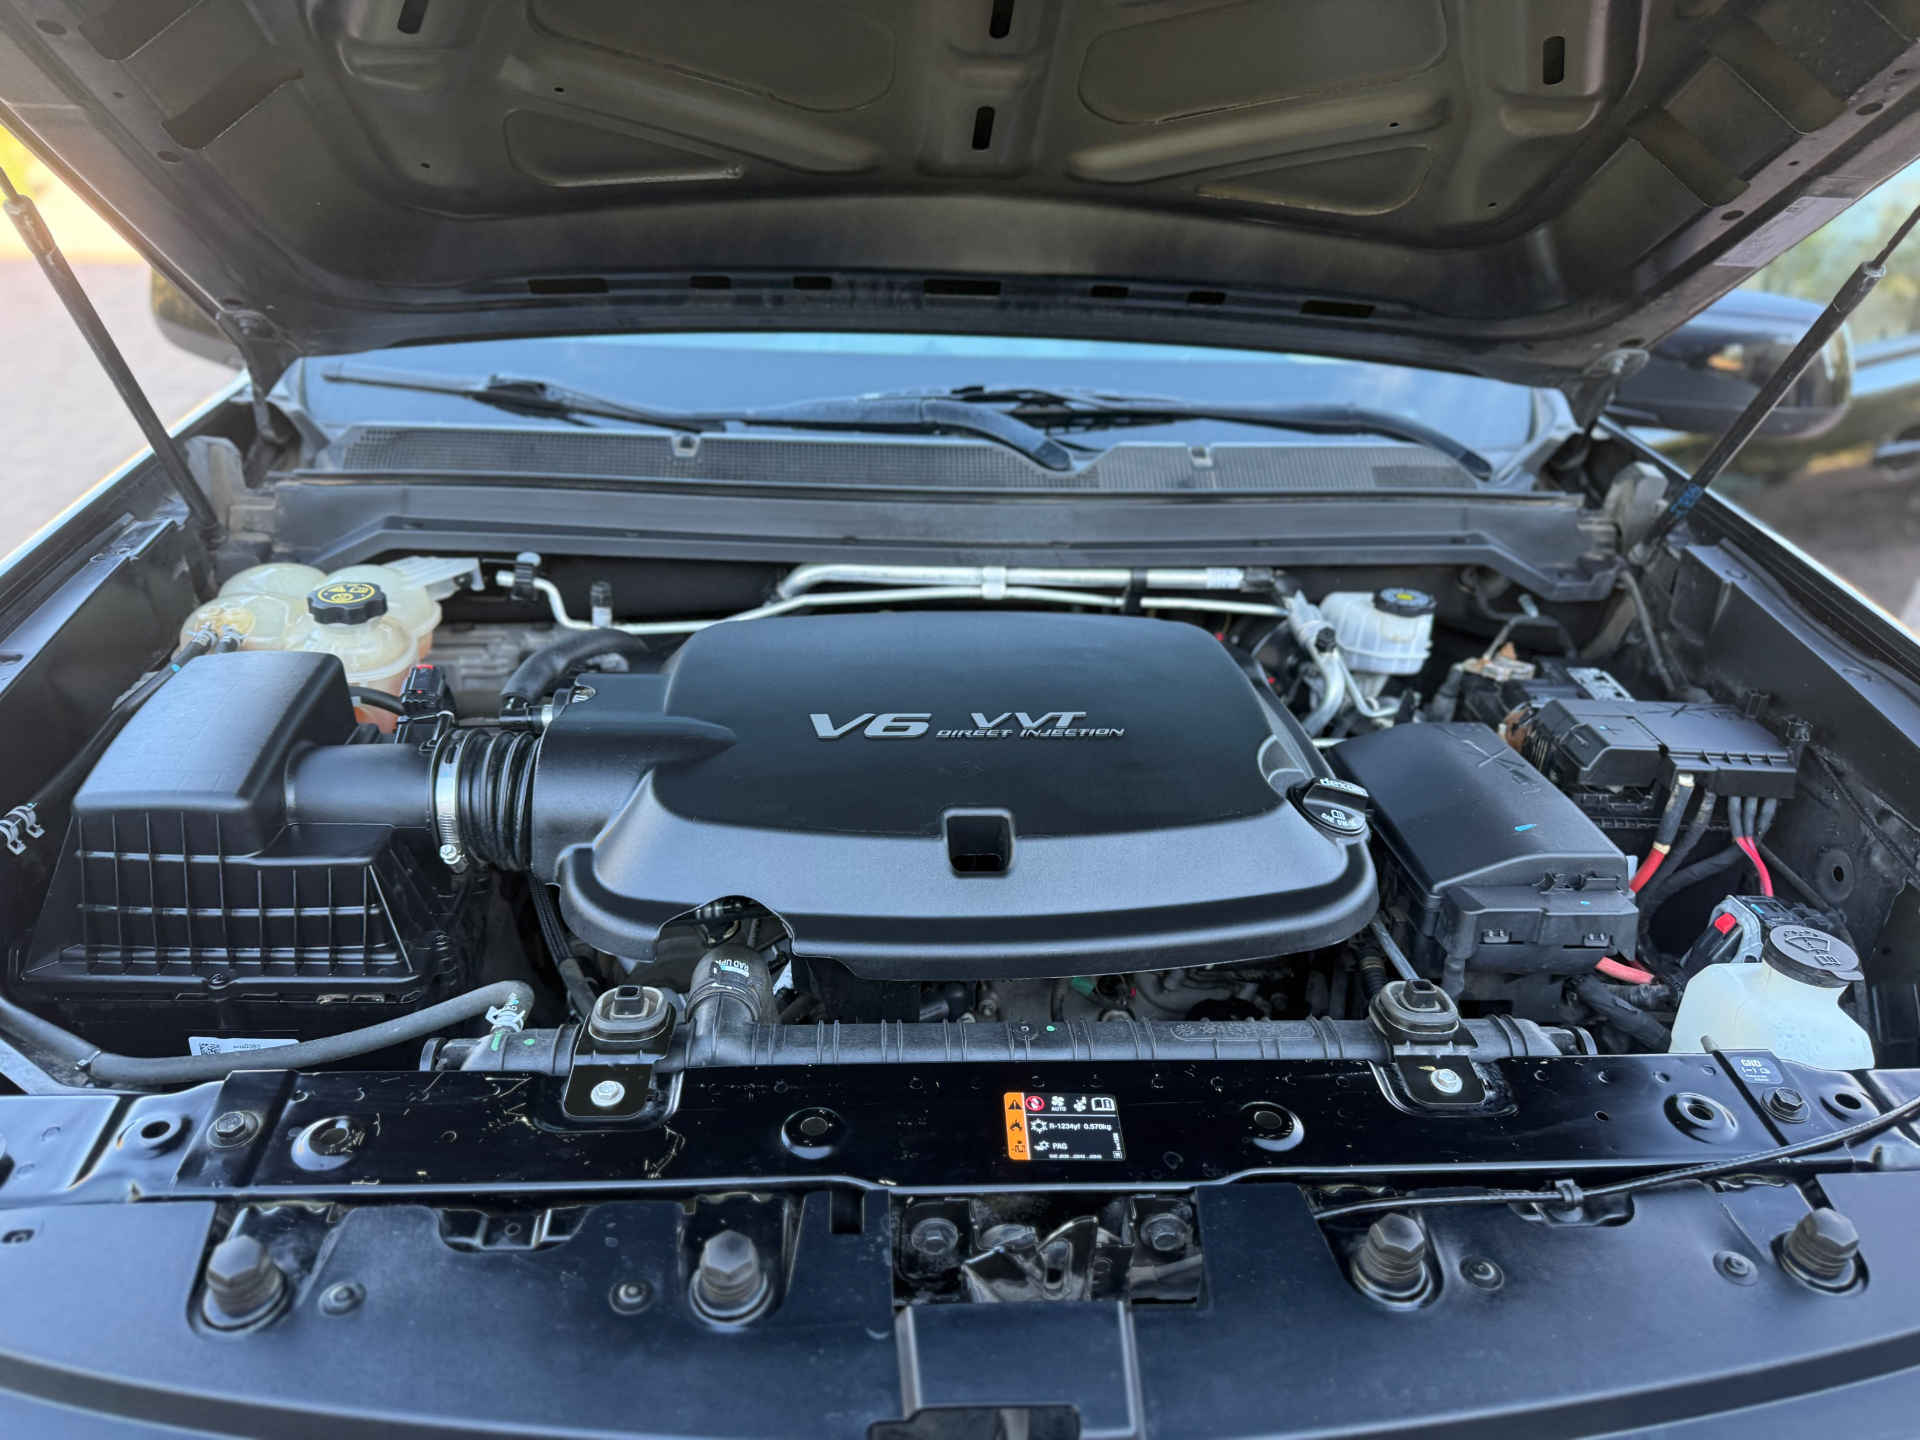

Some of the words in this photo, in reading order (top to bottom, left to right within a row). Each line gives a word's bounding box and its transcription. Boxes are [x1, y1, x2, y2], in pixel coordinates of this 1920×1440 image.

[810, 713, 932, 738] V6
[971, 712, 1087, 729] VVT
[936, 729, 1014, 738] DIRECT
[1020, 728, 1125, 738] INJECTION
[1740, 1059, 1762, 1067] GND
[1049, 1123, 1081, 1131] R-1234yf
[1083, 1123, 1112, 1131] 0.570kg
[1052, 1142, 1068, 1150] PAG
